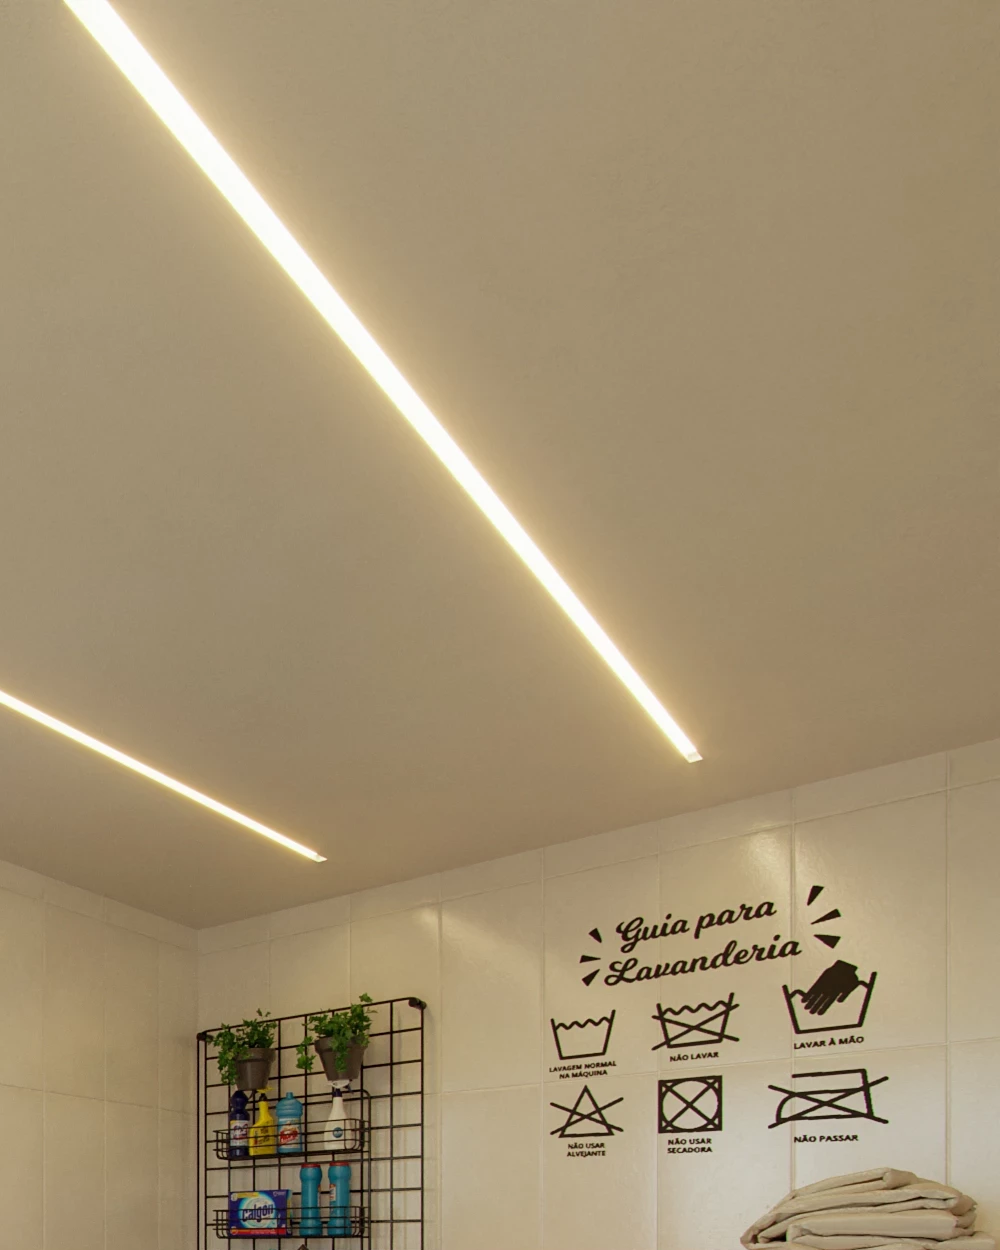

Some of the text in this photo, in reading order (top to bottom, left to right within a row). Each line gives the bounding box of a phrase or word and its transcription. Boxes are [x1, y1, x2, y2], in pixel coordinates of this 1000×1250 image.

[615, 901, 777, 954] Guia para
[604, 934, 803, 987] Lavanderia
[793, 1040, 826, 1050] LAVAR
[838, 1035, 865, 1045] MÃO
[669, 1051, 719, 1062] NÃO LAVAR
[549, 1060, 617, 1073] LAVAGEM NORMAL
[571, 1069, 608, 1078] MÁQUINA
[667, 1137, 712, 1145] NÃO USAR
[793, 1134, 859, 1143] NÃO PASSAR
[567, 1142, 584, 1150] NÃO
[667, 1146, 713, 1154] SECADORA
[566, 1150, 606, 1158] ALVEJANTE
[242, 1203, 274, 1223] Calgon
